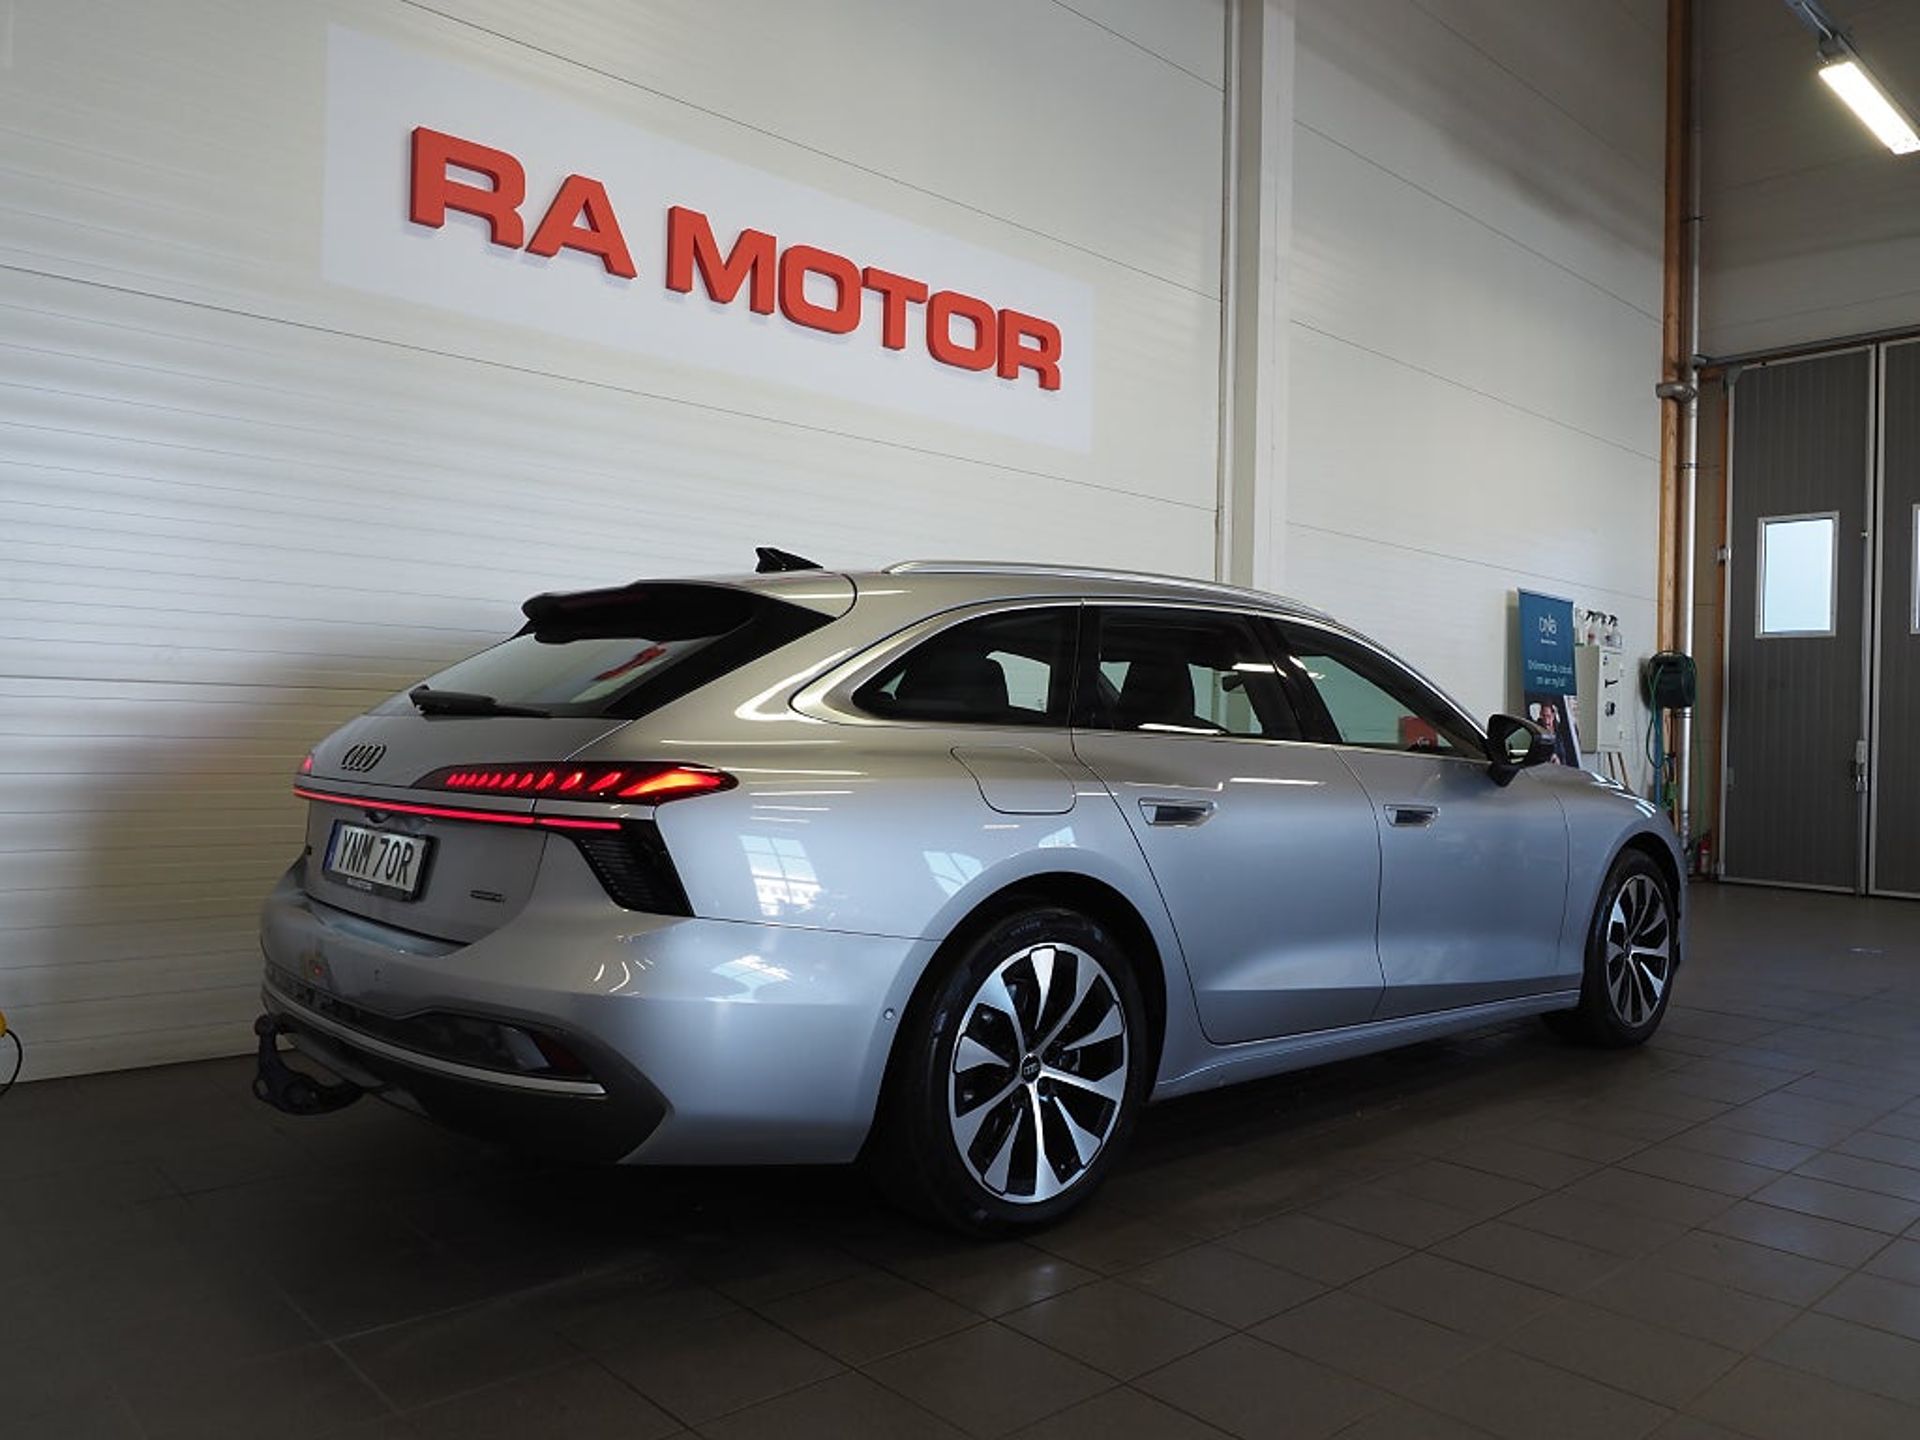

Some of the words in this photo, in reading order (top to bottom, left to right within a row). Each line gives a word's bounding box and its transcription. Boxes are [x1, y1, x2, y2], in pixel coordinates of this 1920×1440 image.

[409, 126, 637, 279] RA
[665, 205, 1062, 391] MOTOR
[338, 829, 376, 875] YNM
[372, 837, 414, 886] 70R
